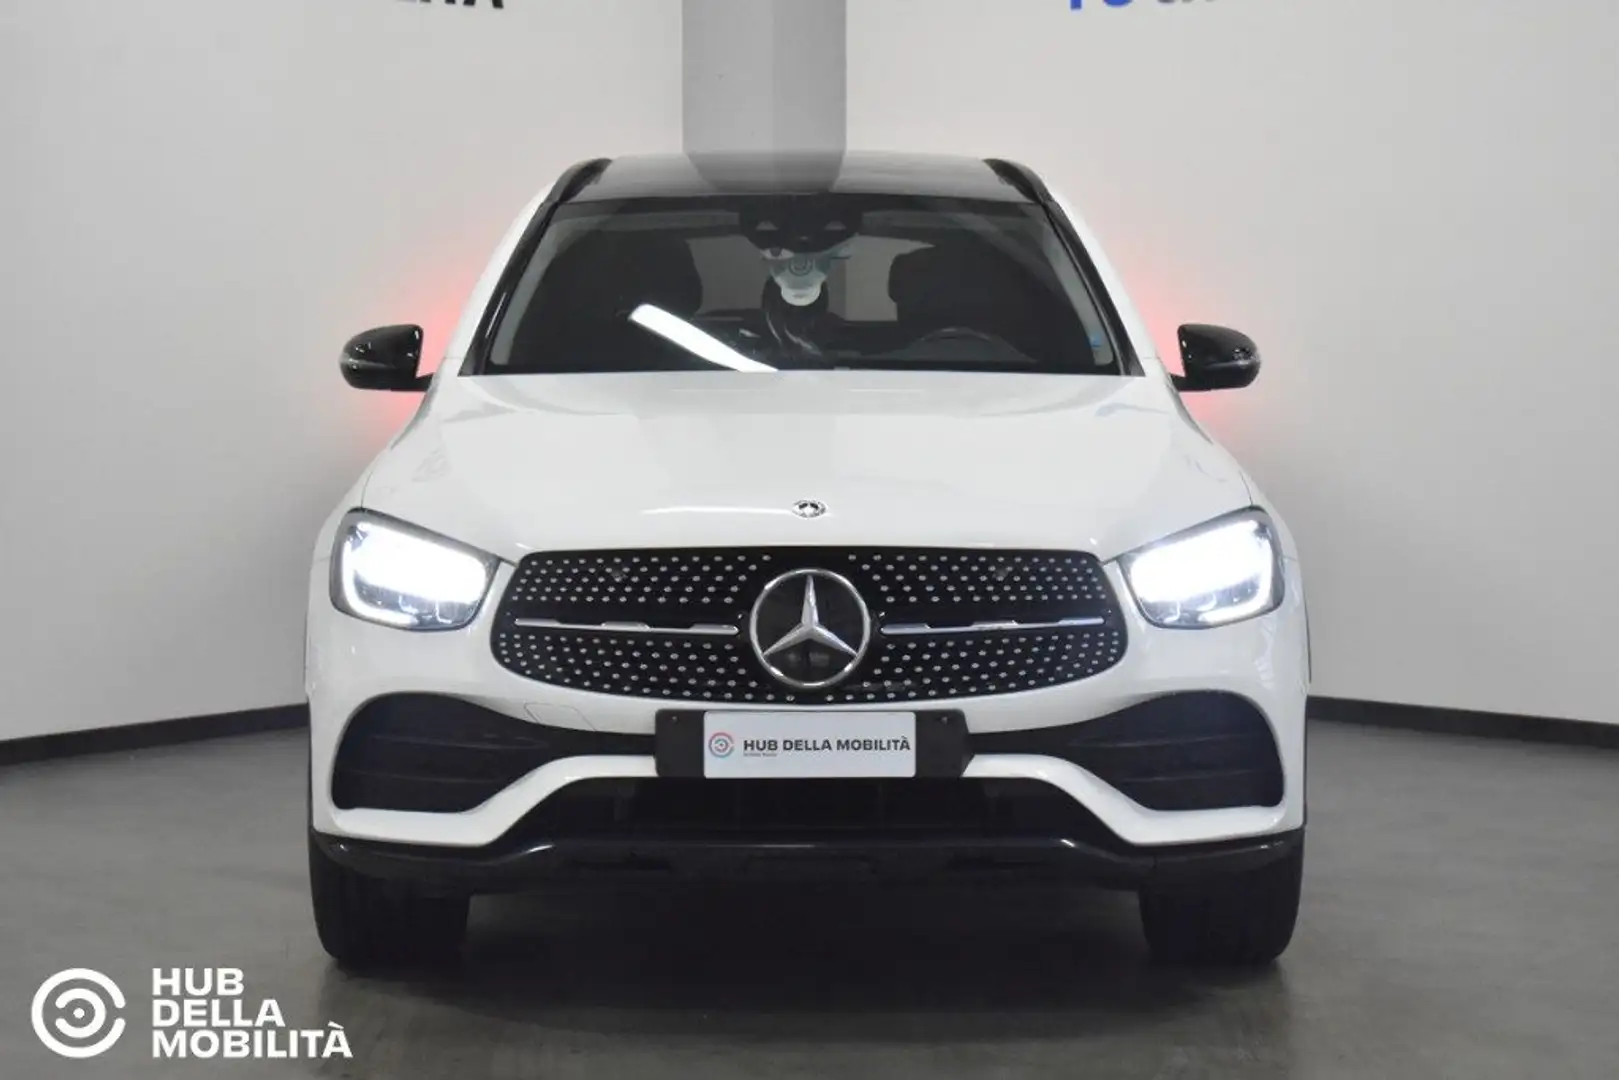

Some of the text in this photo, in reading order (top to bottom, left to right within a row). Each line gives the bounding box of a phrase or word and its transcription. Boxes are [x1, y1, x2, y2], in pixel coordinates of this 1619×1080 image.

[743, 736, 911, 751] HUB DELLA MOBILITÀ
